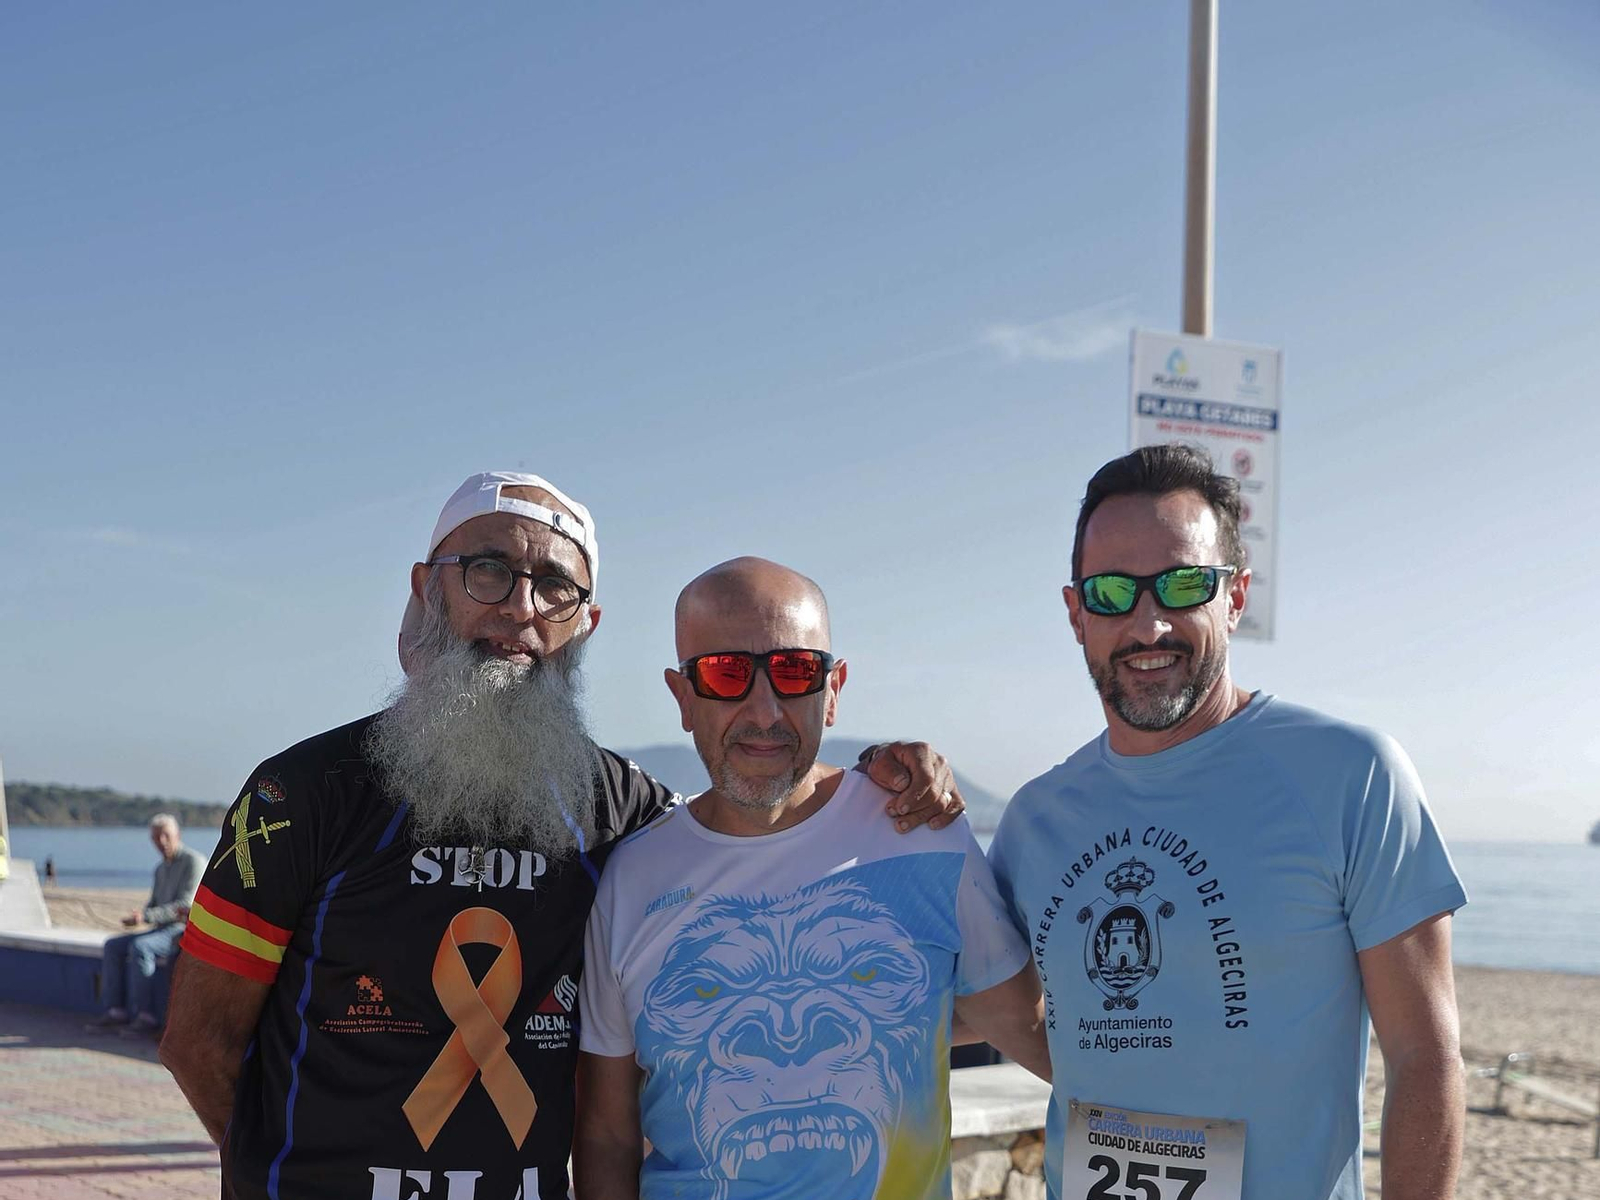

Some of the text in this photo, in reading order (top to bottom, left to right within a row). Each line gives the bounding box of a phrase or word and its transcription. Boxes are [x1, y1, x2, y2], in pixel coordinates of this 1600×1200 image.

[1061, 827, 1132, 889] URBANA
[1142, 826, 1209, 877] CIUDAD
[411, 847, 546, 891] STOP
[1196, 878, 1226, 908] DE
[1035, 895, 1064, 982] CARRERA
[1208, 916, 1249, 1030] ALGECIRAS
[347, 1004, 393, 1016] ACELA
[1078, 1016, 1173, 1034] Ayuntamiento
[1078, 1033, 1173, 1053] de Algeciras
[1089, 1108, 1103, 1118] XXIV
[1088, 1117, 1206, 1145] CARRERA URBANA
[1088, 1131, 1206, 1160] CIUDAD DE ALGECIRAS
